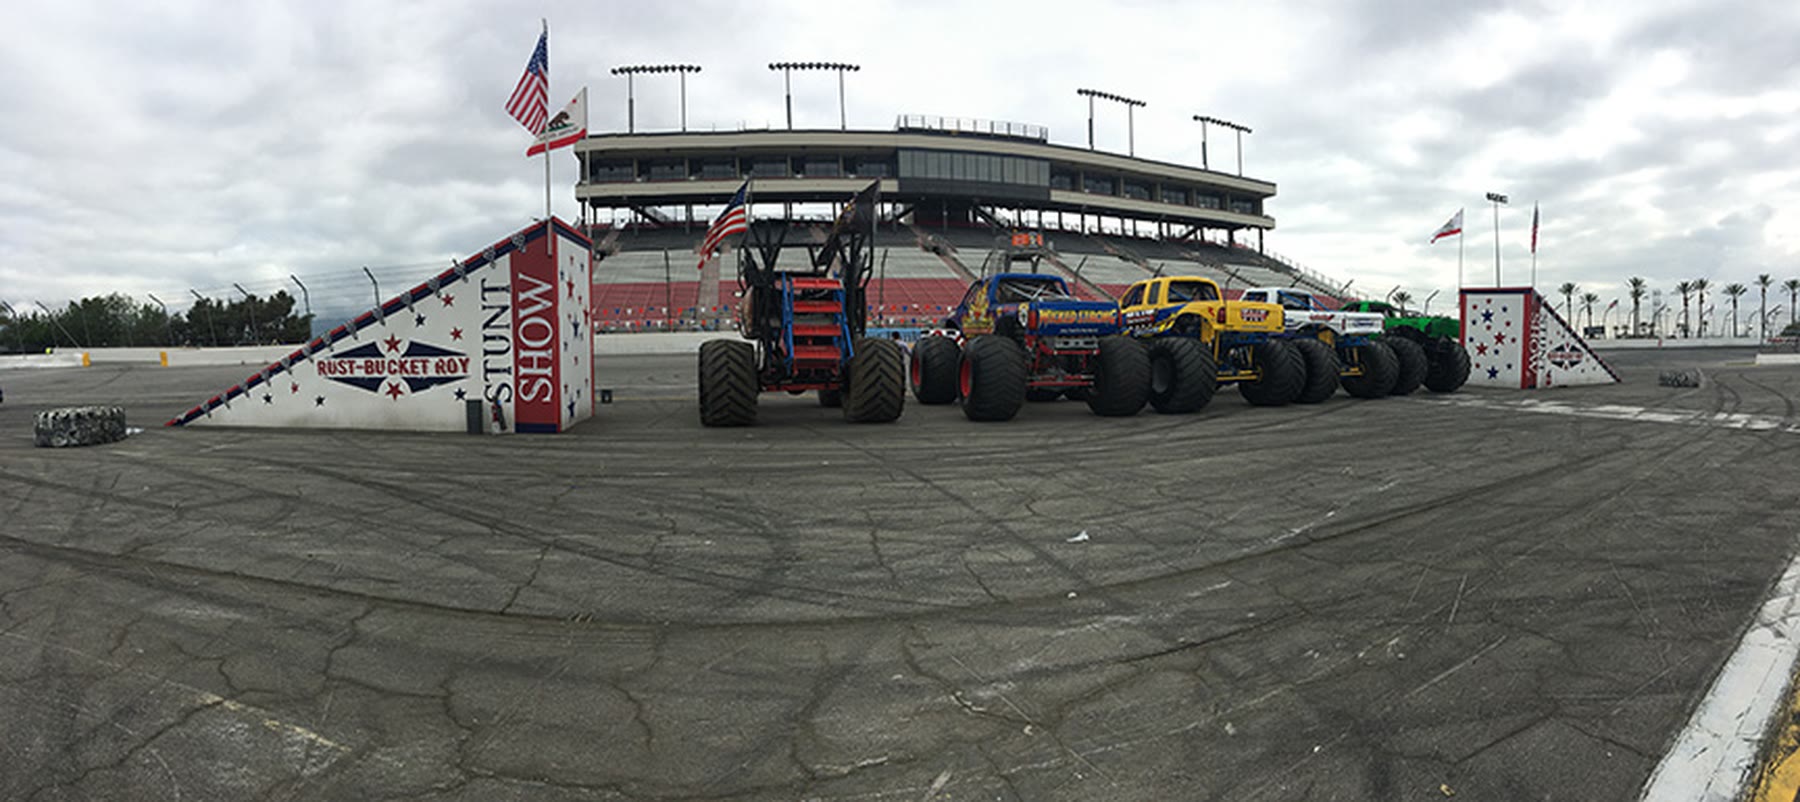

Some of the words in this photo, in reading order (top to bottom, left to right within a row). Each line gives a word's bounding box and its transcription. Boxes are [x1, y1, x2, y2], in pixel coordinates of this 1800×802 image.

[317, 357, 430, 376] RUST-BUCKET
[435, 357, 471, 375] ROY
[481, 278, 512, 404] STUNT
[518, 273, 554, 403] SHOW
[1528, 312, 1540, 374] SHOW
